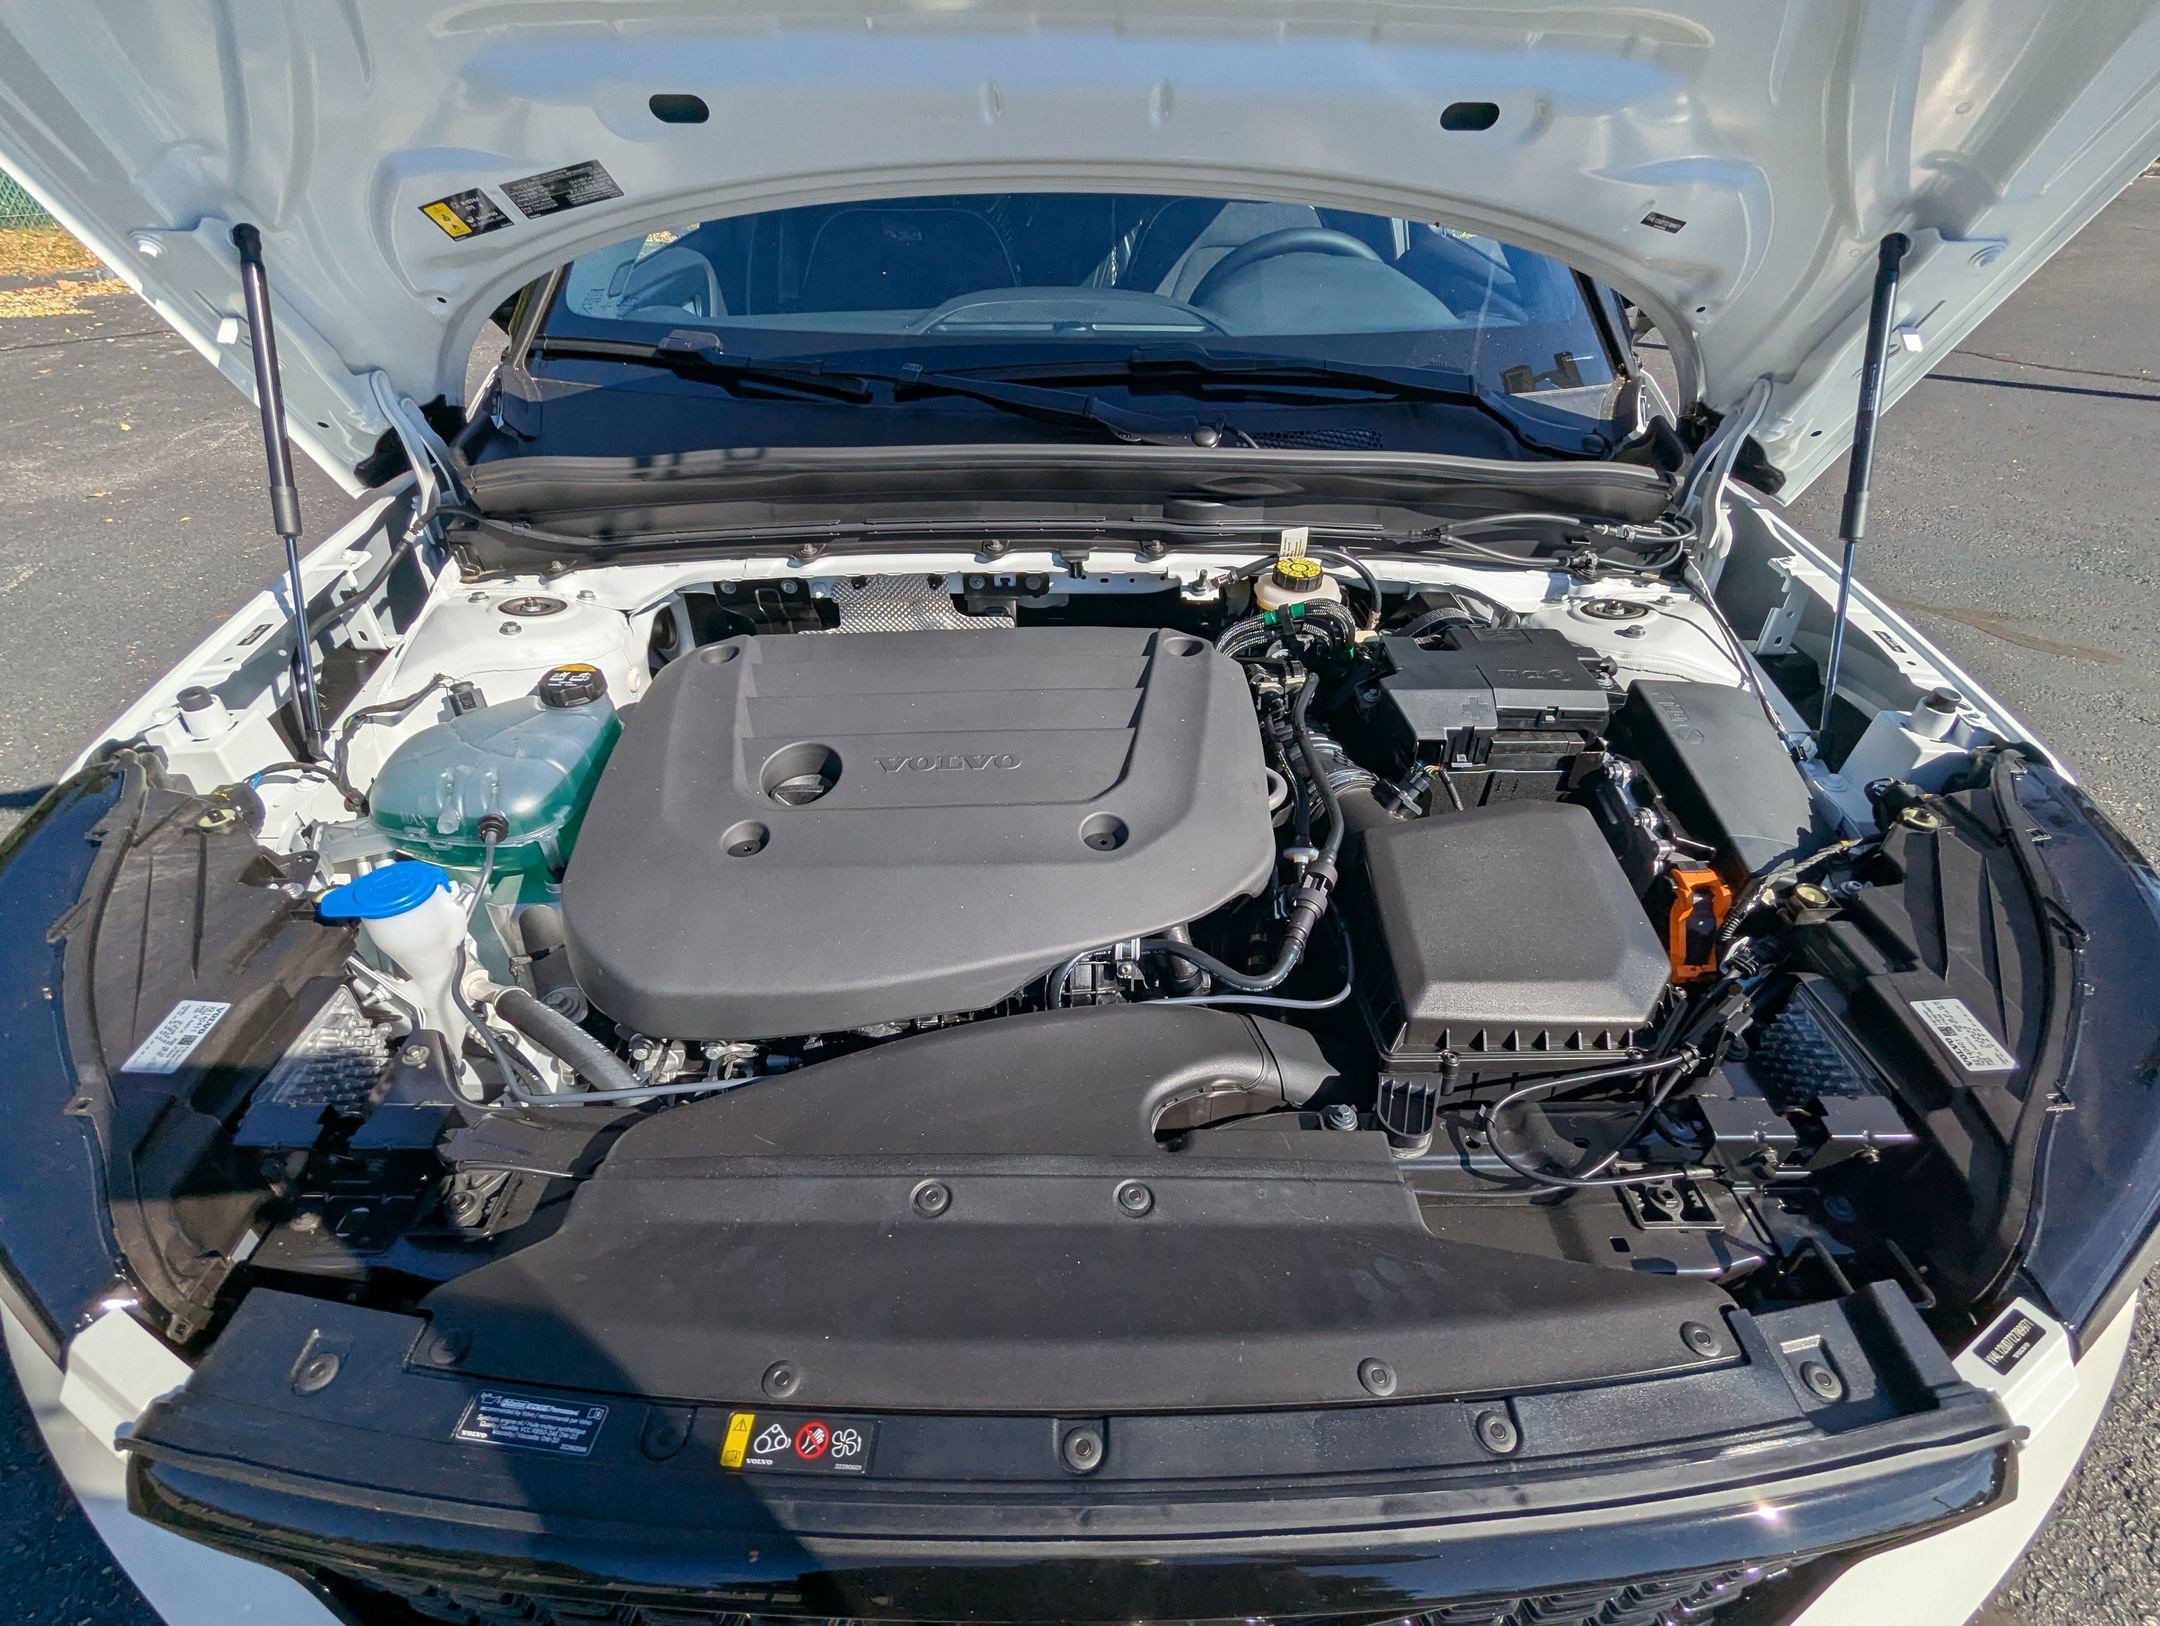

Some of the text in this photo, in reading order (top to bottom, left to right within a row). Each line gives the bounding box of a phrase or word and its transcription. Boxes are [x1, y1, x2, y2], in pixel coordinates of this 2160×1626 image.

[874, 752, 1023, 774] VOLVO
[197, 1006, 226, 1035] VOLVO
[1945, 1037, 1974, 1067] VOLVO
[2012, 1342, 2031, 1358] VOLVO
[461, 1429, 488, 1438] VOLVO
